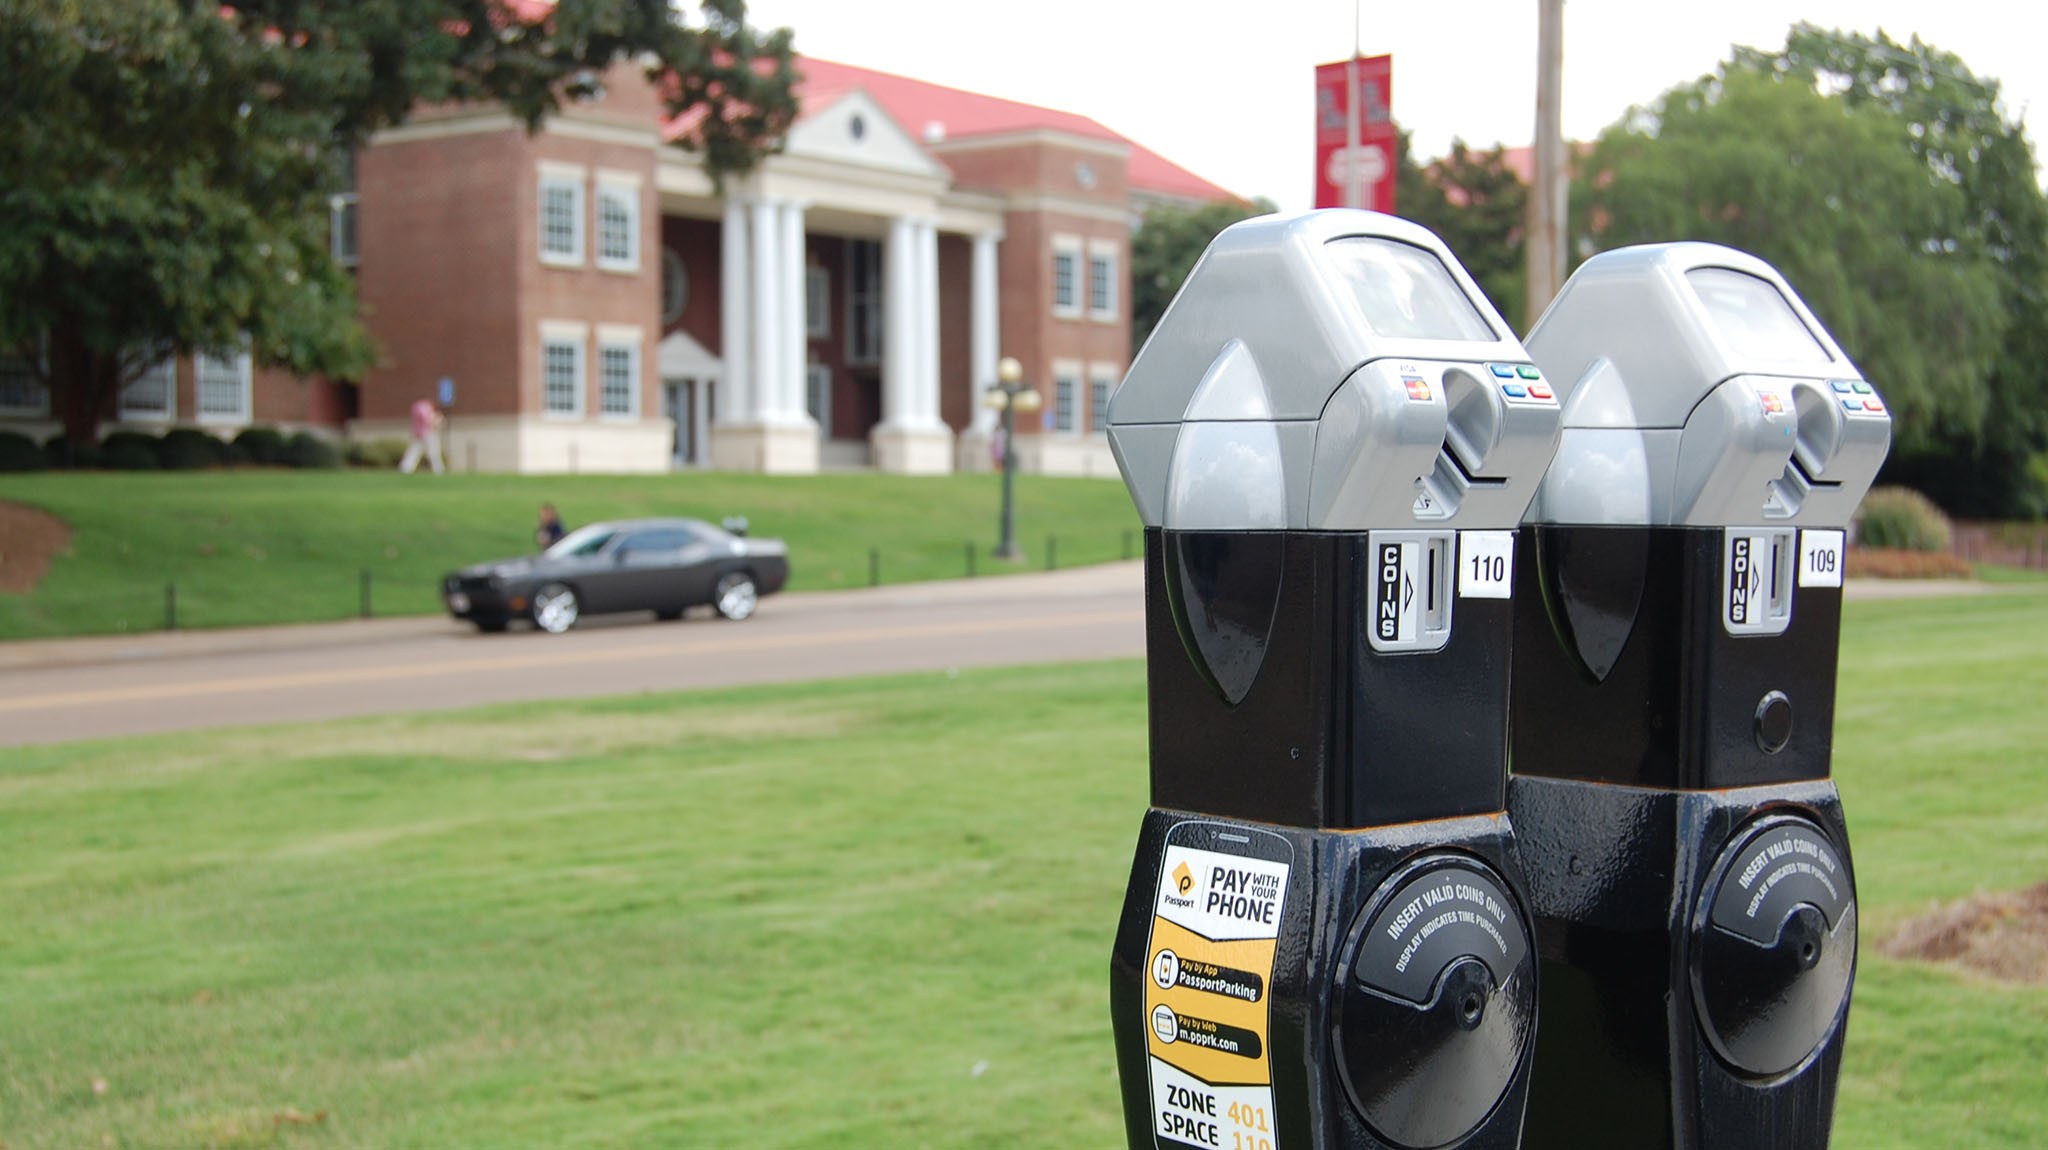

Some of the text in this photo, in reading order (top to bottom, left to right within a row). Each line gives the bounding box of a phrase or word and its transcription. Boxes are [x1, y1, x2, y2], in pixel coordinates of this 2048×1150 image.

[1471, 555, 1504, 582] 110
[1809, 549, 1836, 573] 109
[1381, 547, 1398, 637] COINS
[1732, 540, 1748, 621] COINS
[1210, 866, 1280, 894] PAY WITH
[1738, 850, 1769, 890] INSERT
[1767, 839, 1793, 860] VALID
[1793, 838, 1818, 858] COINS
[1164, 895, 1194, 908] Passport
[1251, 886, 1277, 900] YOUR
[1746, 882, 1769, 918] DISPLAY
[1767, 862, 1797, 888] INDICATES
[1206, 891, 1275, 924] PHONE
[1387, 883, 1506, 941] INSERT VALID COINS ONLY
[1395, 933, 1423, 973] DISPLAY
[1420, 911, 1458, 939] INDICATES
[1458, 911, 1475, 924] TIME
[1180, 960, 1218, 977] Pay by App
[1179, 971, 1257, 1002] PassportParking
[1178, 1016, 1190, 1027] Pay
[1192, 1018, 1201, 1030] by
[1201, 1021, 1217, 1032] Web
[1179, 1029, 1239, 1052] m.ppprk.com
[1167, 1083, 1269, 1133] ZONE 401
[1162, 1111, 1219, 1146] SPACE
